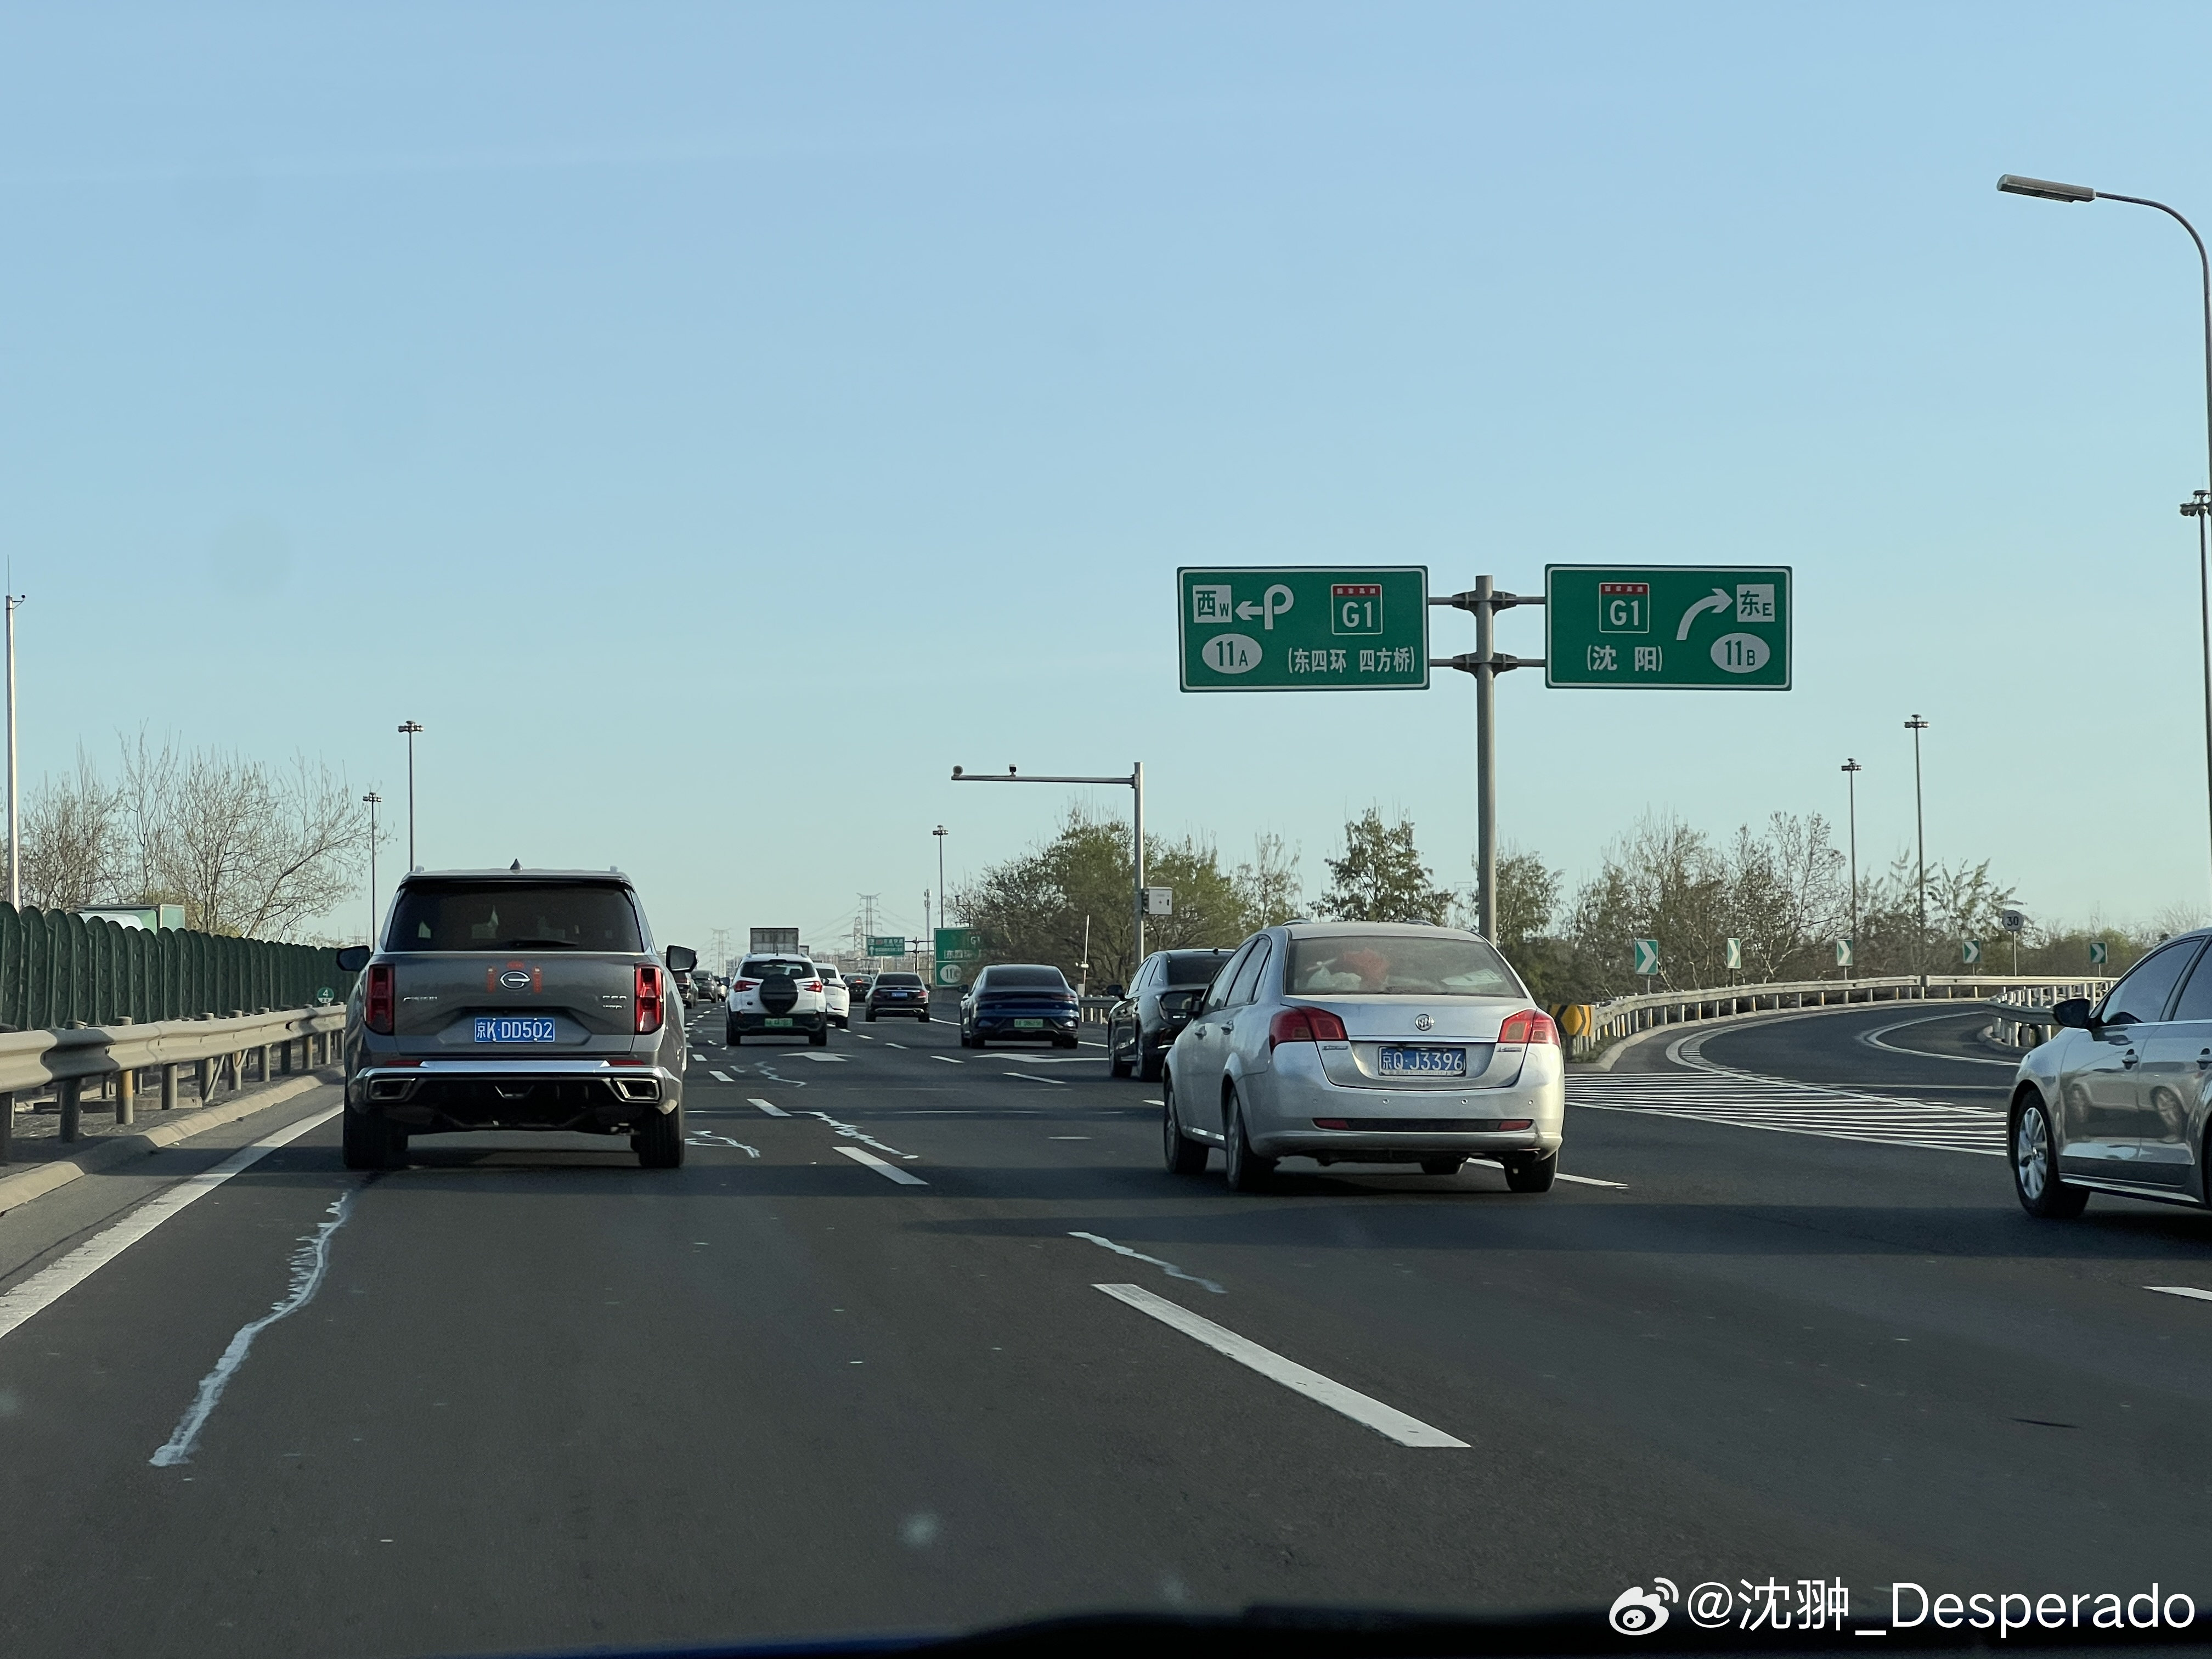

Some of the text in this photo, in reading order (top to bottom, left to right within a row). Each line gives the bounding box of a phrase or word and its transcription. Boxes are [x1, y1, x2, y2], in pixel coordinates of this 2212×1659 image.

[1342, 601, 1372, 628] G1
[1610, 600, 1639, 625] G1
[1216, 641, 1248, 667] 11A
[1288, 646, 1415, 674] (东四环 四方桥)
[1725, 640, 1756, 666] 11B
[2006, 916, 2019, 927] 30
[323, 989, 329, 997] 4
